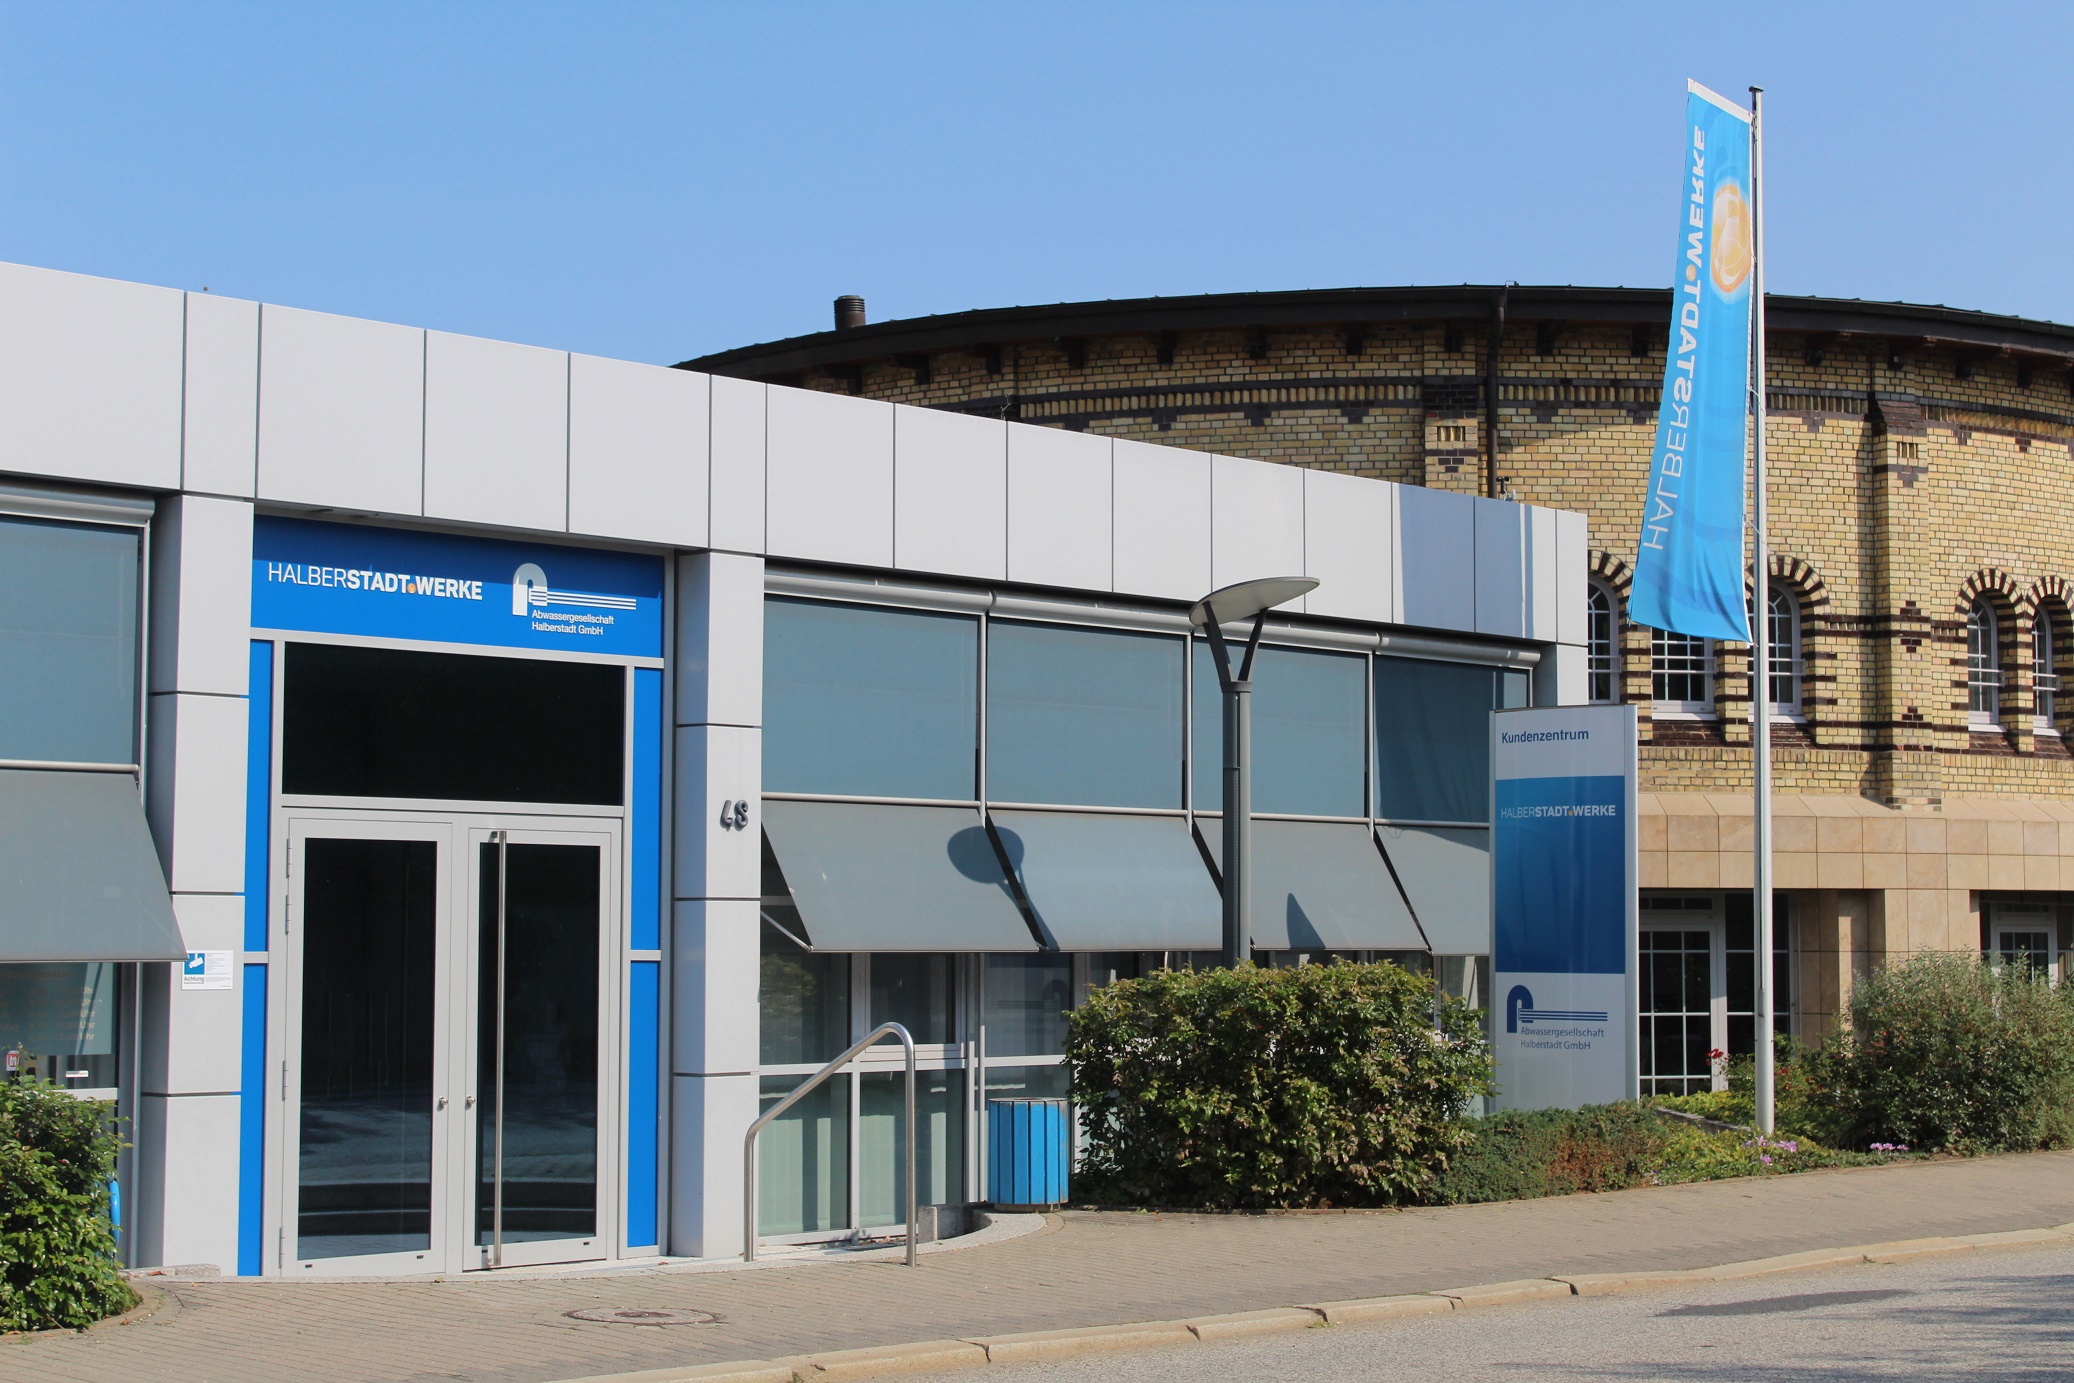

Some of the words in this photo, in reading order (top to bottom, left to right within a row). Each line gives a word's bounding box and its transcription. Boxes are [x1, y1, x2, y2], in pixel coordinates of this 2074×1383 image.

[532, 609, 615, 625] Abwassergesellschaft
[532, 621, 577, 633] Halberstadt
[578, 625, 604, 636] GmbH
[1502, 729, 1589, 744] Kundenzentrum
[1520, 1026, 1605, 1038] Abwassergesellschaft
[1520, 1040, 1562, 1049] Halberstadt
[1563, 1040, 1591, 1050] GmbH
